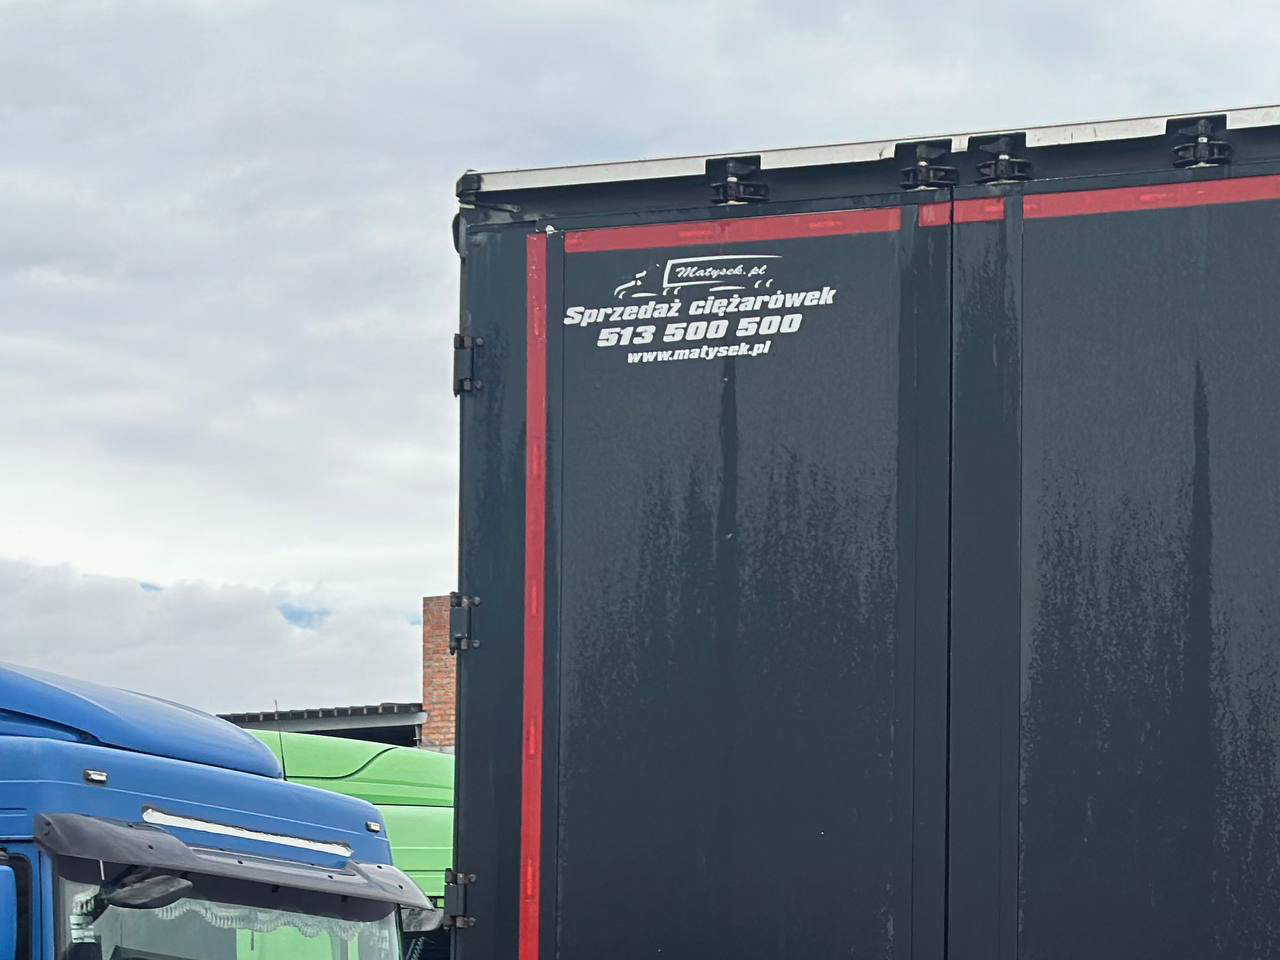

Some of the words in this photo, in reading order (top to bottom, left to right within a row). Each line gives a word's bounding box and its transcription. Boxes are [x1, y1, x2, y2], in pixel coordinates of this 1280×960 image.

[675, 264, 768, 279] Matysek.pl
[563, 299, 681, 327] Sprzedaż
[688, 286, 837, 317] ciężarówek
[597, 325, 656, 347] 513
[663, 319, 729, 343] 500
[736, 313, 803, 337] 500
[627, 341, 771, 364] www.matysek.pl
